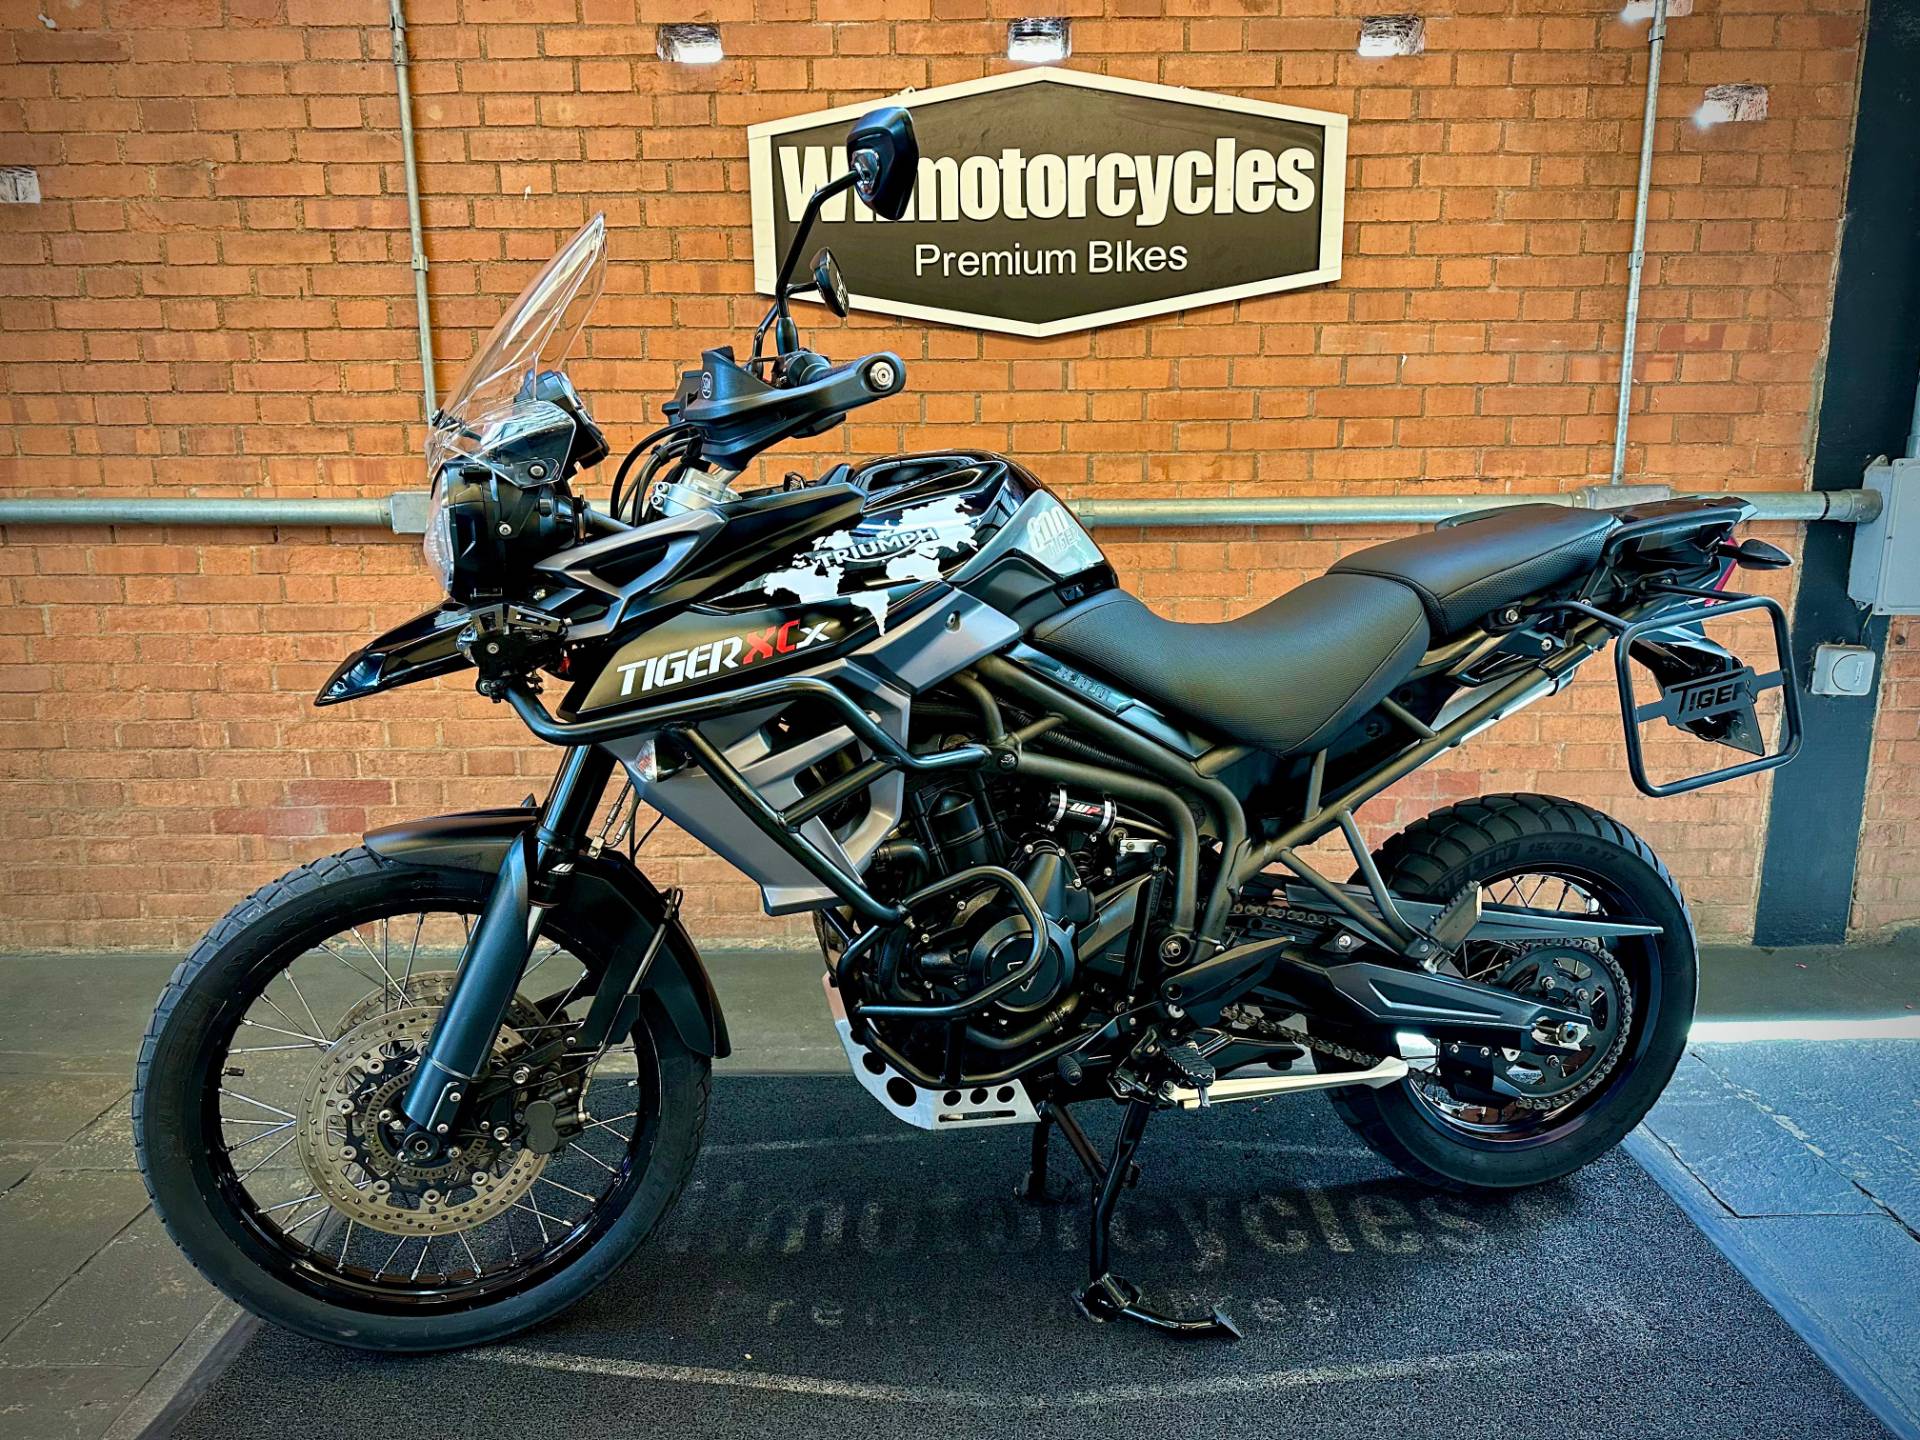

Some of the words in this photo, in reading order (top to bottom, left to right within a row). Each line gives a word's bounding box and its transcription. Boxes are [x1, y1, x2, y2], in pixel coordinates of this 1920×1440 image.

[779, 137, 1316, 226] Wmotorcycles
[915, 243, 1077, 277] Premium
[815, 526, 940, 568] TRIUMPH
[616, 635, 743, 697] TIGER
